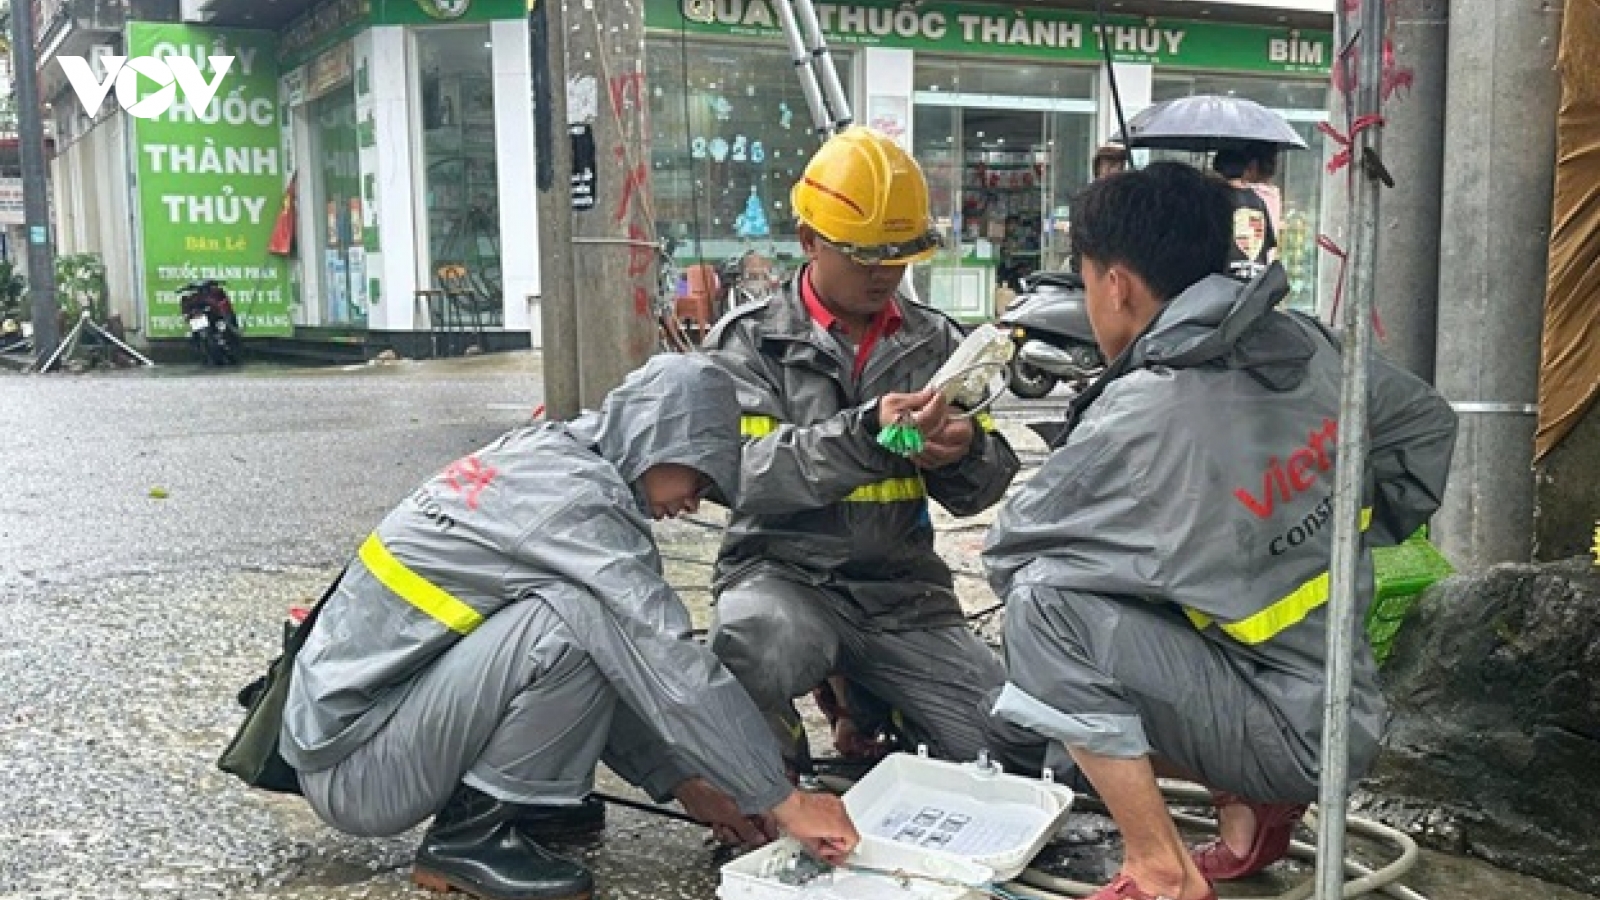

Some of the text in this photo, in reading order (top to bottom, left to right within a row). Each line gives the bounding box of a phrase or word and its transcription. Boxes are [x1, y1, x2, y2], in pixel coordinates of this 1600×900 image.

[817, 1, 948, 40] THUỐC
[958, 9, 1083, 47] THÀNH
[1091, 17, 1186, 54] THỦY
[143, 136, 279, 176] THÀNH
[161, 184, 268, 225] THỦY
[1268, 490, 1335, 556] cons
